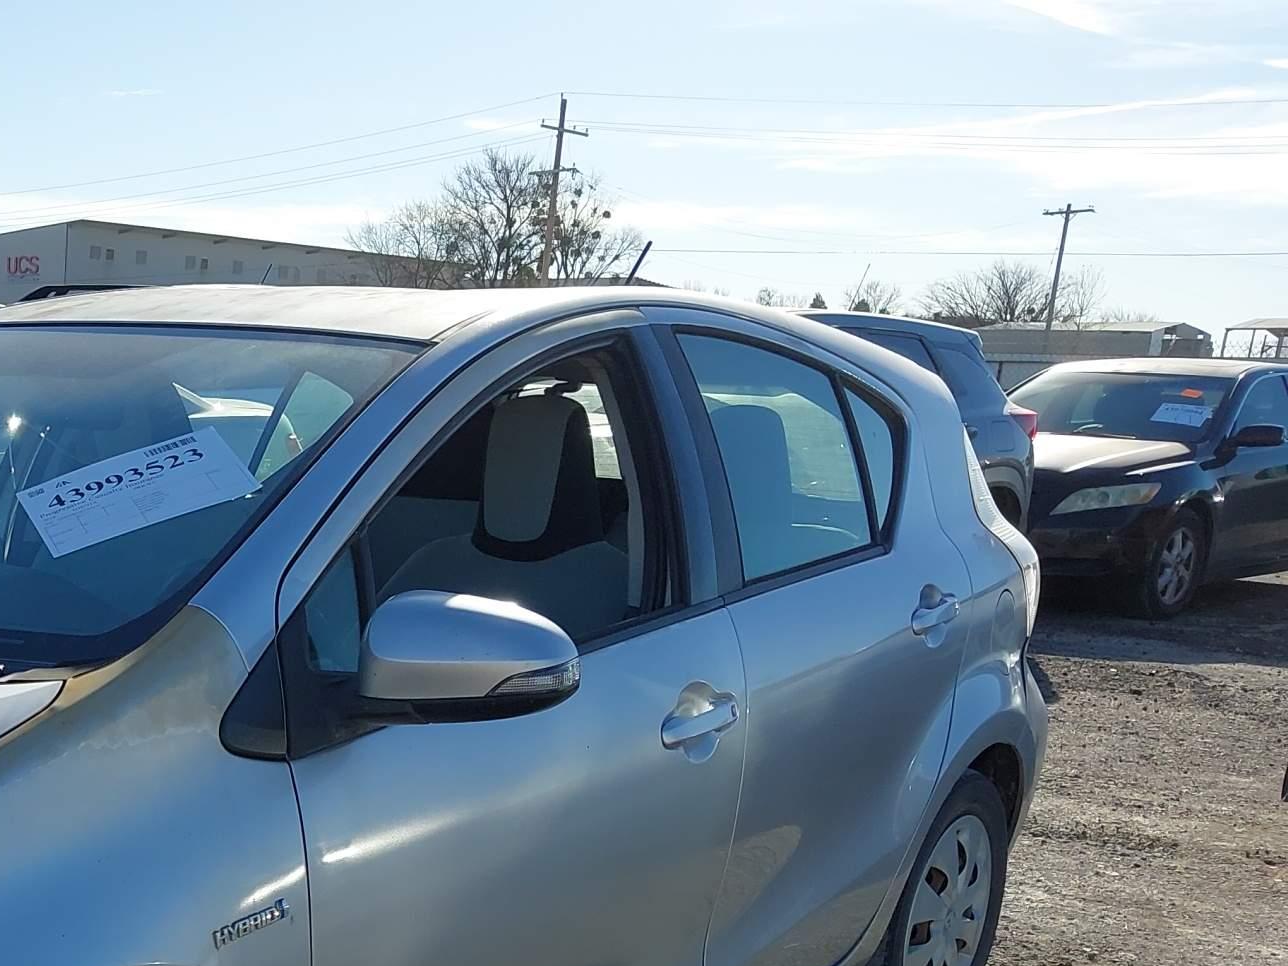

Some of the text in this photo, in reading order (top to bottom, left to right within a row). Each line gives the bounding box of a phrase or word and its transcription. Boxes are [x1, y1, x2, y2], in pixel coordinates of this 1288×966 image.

[6, 255, 40, 274] UCS
[48, 448, 204, 508] 43993523
[212, 905, 281, 950] HYBRID
